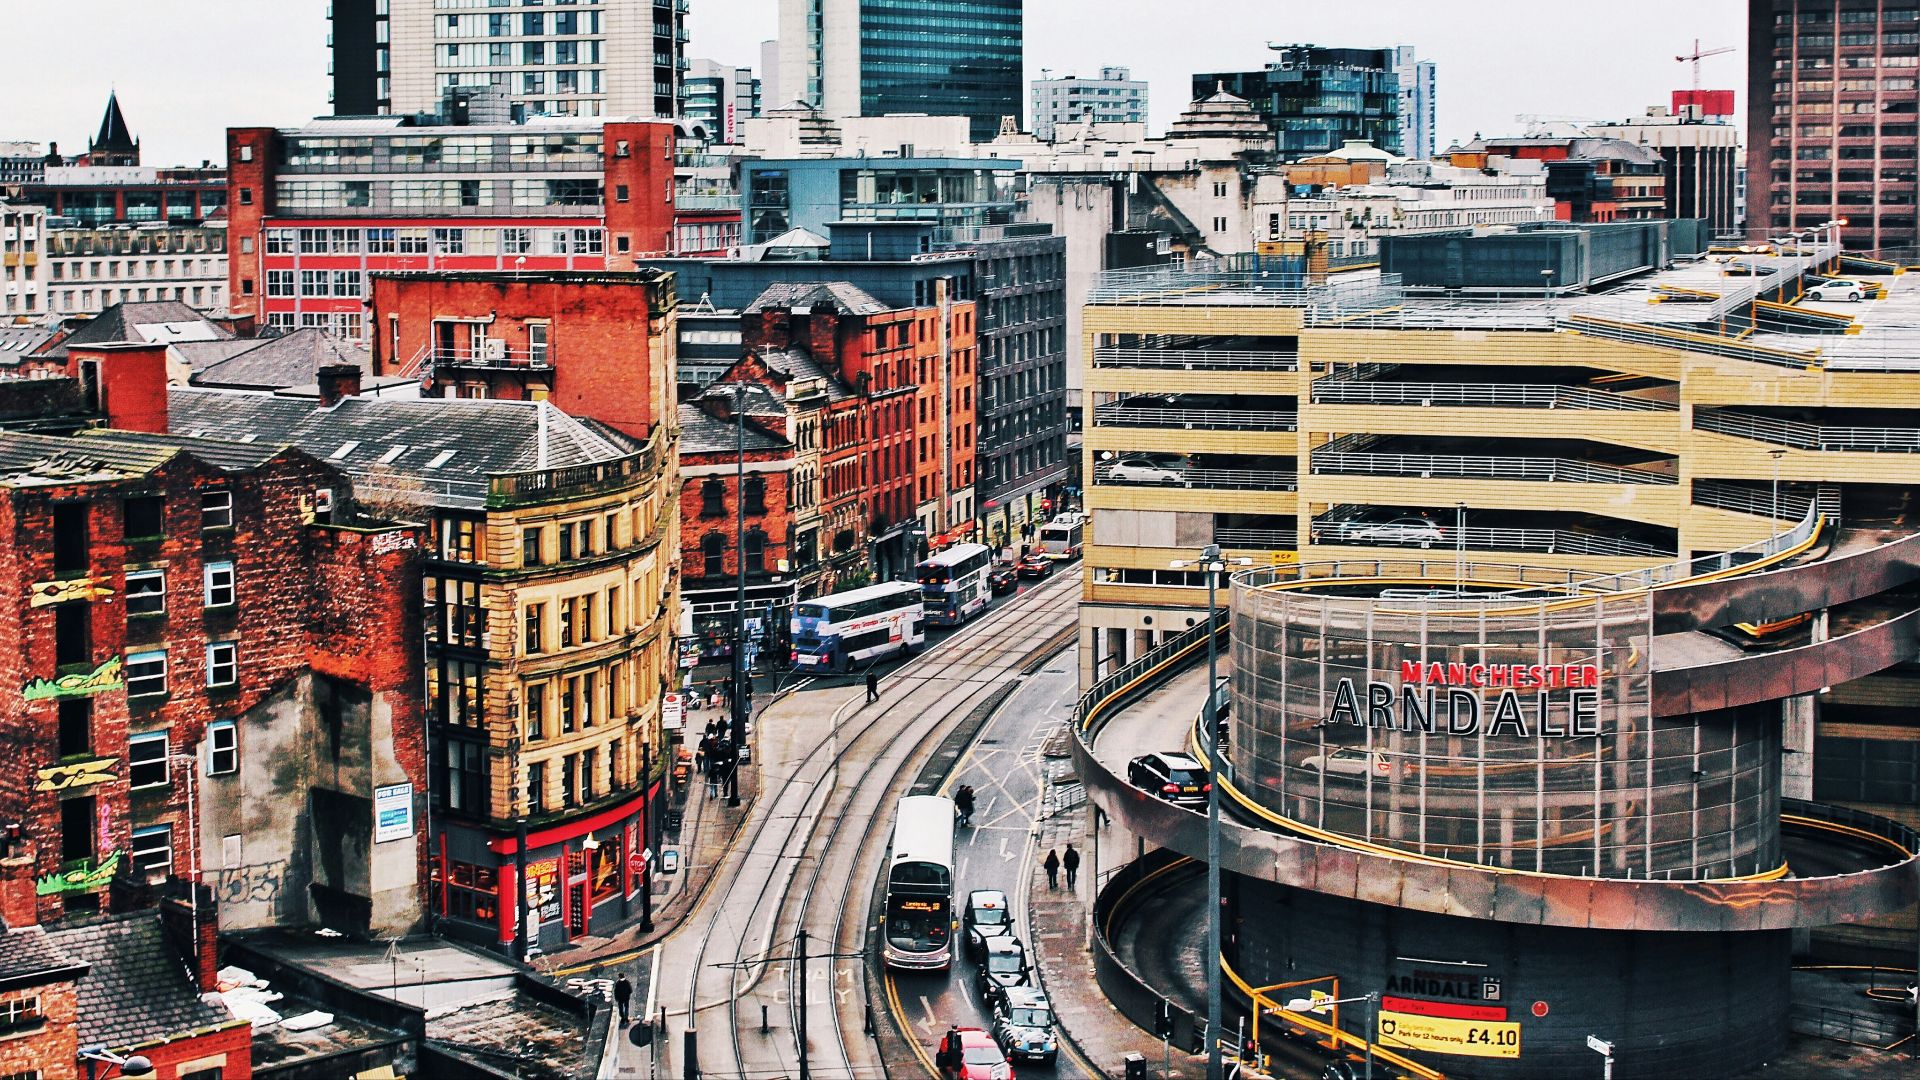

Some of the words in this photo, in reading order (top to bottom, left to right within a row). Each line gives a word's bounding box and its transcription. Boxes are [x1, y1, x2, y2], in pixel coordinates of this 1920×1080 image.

[1402, 660, 1599, 688] MANCHESTER
[1327, 677, 1600, 738] ARNDALE
[508, 688, 520, 818] CHAMBERS
[1386, 974, 1479, 1000] ARNDALE
[1412, 1031, 1422, 1039] for
[1431, 1034, 1449, 1042] hours
[1449, 1036, 1464, 1045] only
[1466, 1028, 1517, 1046] £4.10
